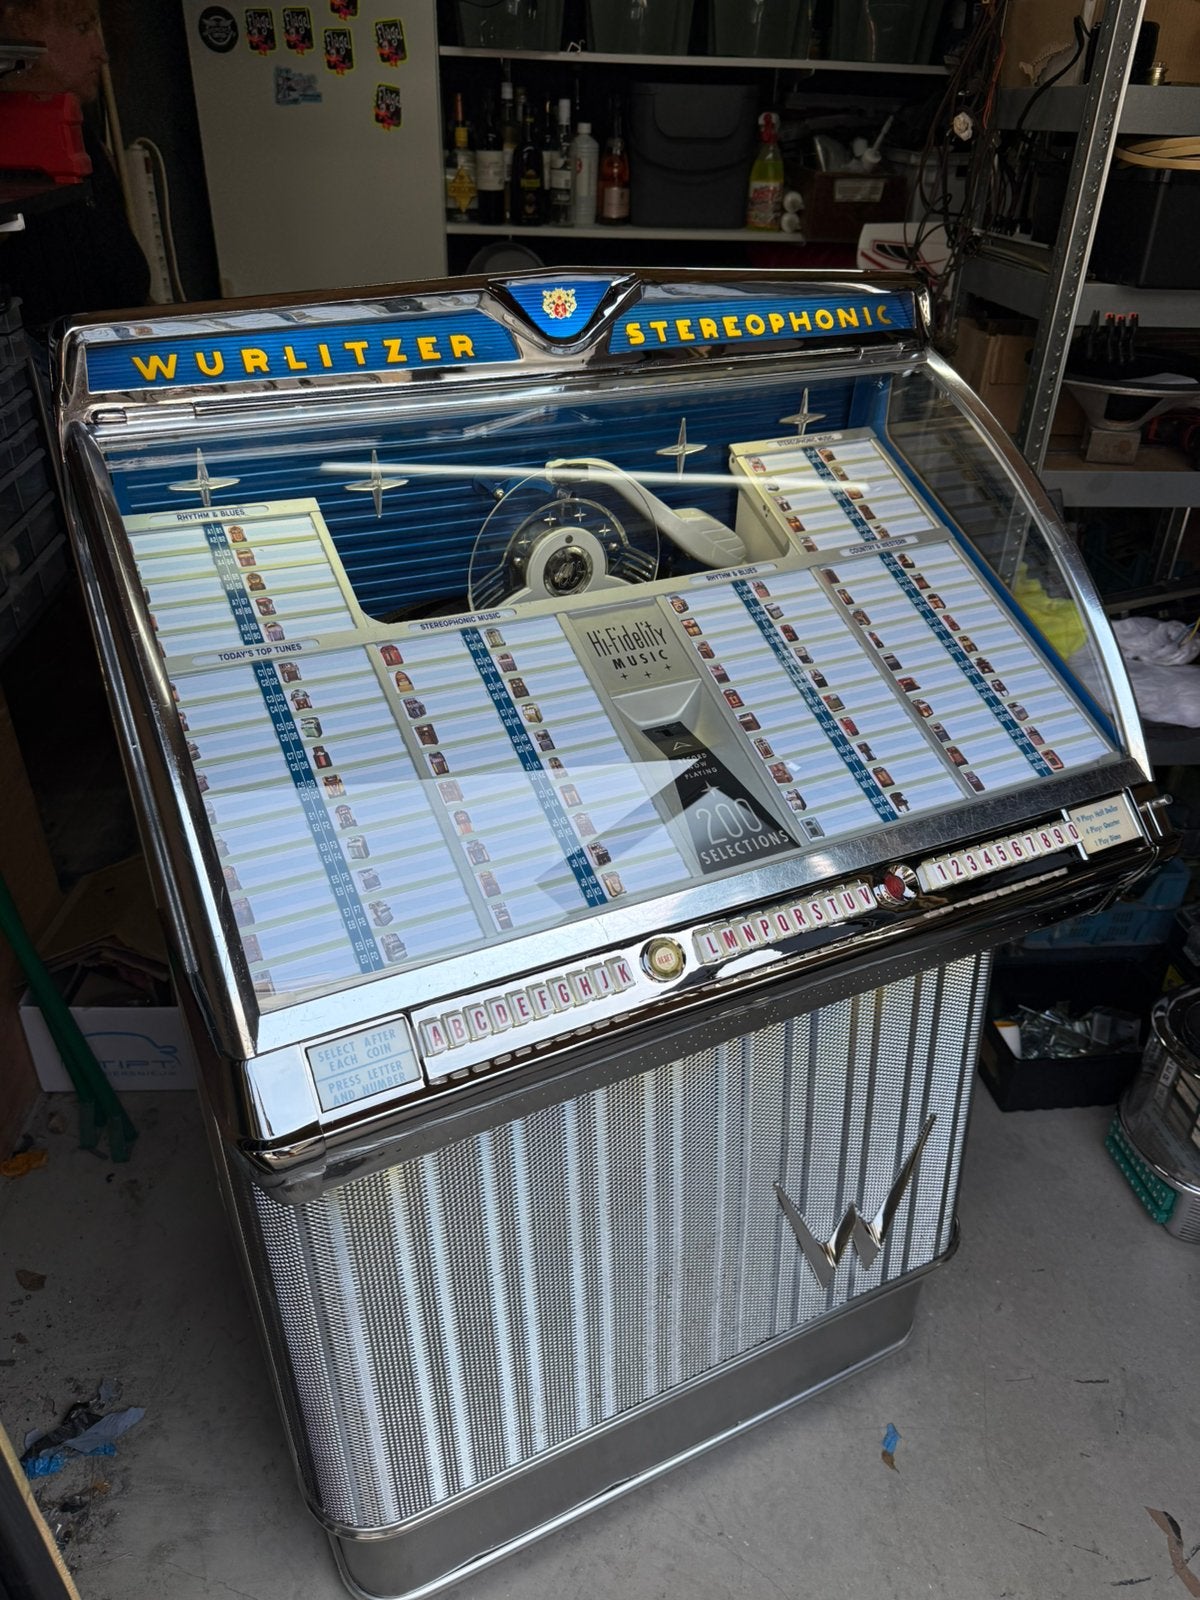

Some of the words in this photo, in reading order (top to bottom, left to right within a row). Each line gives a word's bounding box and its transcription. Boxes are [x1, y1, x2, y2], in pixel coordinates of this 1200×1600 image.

[625, 303, 892, 346] STEREOPHONIC
[132, 334, 475, 381] WURLITZER
[176, 512, 209, 521] RHYTHM
[220, 508, 246, 517] BLUES
[849, 544, 875, 554] COUNTRY
[706, 572, 731, 581] RHYTHM
[738, 567, 758, 576] BLUES
[420, 616, 476, 630] STEREOPHONIC
[478, 612, 501, 621] MUSIC
[218, 650, 254, 661] TODAY'S
[256, 648, 272, 656] TOP
[275, 643, 302, 653] TUNES
[613, 650, 668, 670] MUSIC
[685, 767, 718, 780] PLAYING
[696, 798, 763, 845] 200
[701, 830, 789, 864] SELECTIONS
[938, 865, 948, 880] 1
[952, 860, 963, 876] 2
[967, 856, 977, 871] 3
[983, 851, 993, 866] 4
[996, 846, 1007, 861] 5
[1011, 841, 1022, 856] 6
[1026, 837, 1035, 851] 7
[1040, 833, 1051, 848] 8
[1054, 829, 1064, 844] 9
[1068, 825, 1079, 840] 0
[707, 937, 718, 954] L
[722, 930, 738, 948] M
[743, 925, 755, 942] N
[760, 920, 770, 936] P
[778, 914, 789, 931] Q
[793, 909, 806, 925] R
[813, 903, 823, 920] S
[828, 898, 839, 914] T
[843, 893, 855, 909] U
[859, 888, 870, 904] V
[432, 1026, 444, 1046] A
[451, 1019, 464, 1038] B
[474, 1011, 487, 1030] C
[496, 1004, 507, 1023] D
[517, 997, 529, 1016] E
[537, 991, 546, 1009] F
[558, 984, 569, 1003] G
[579, 977, 592, 996] H
[602, 971, 609, 989] J
[618, 964, 631, 983] K
[318, 1042, 354, 1062] SELECT
[364, 1028, 396, 1048] AFTER
[330, 1056, 358, 1072] EACH
[367, 1043, 391, 1059] COIN
[328, 1074, 361, 1094] PRESS
[368, 1061, 403, 1080] LETTER
[333, 1091, 356, 1106] AND
[362, 1072, 406, 1095] NUMBER
